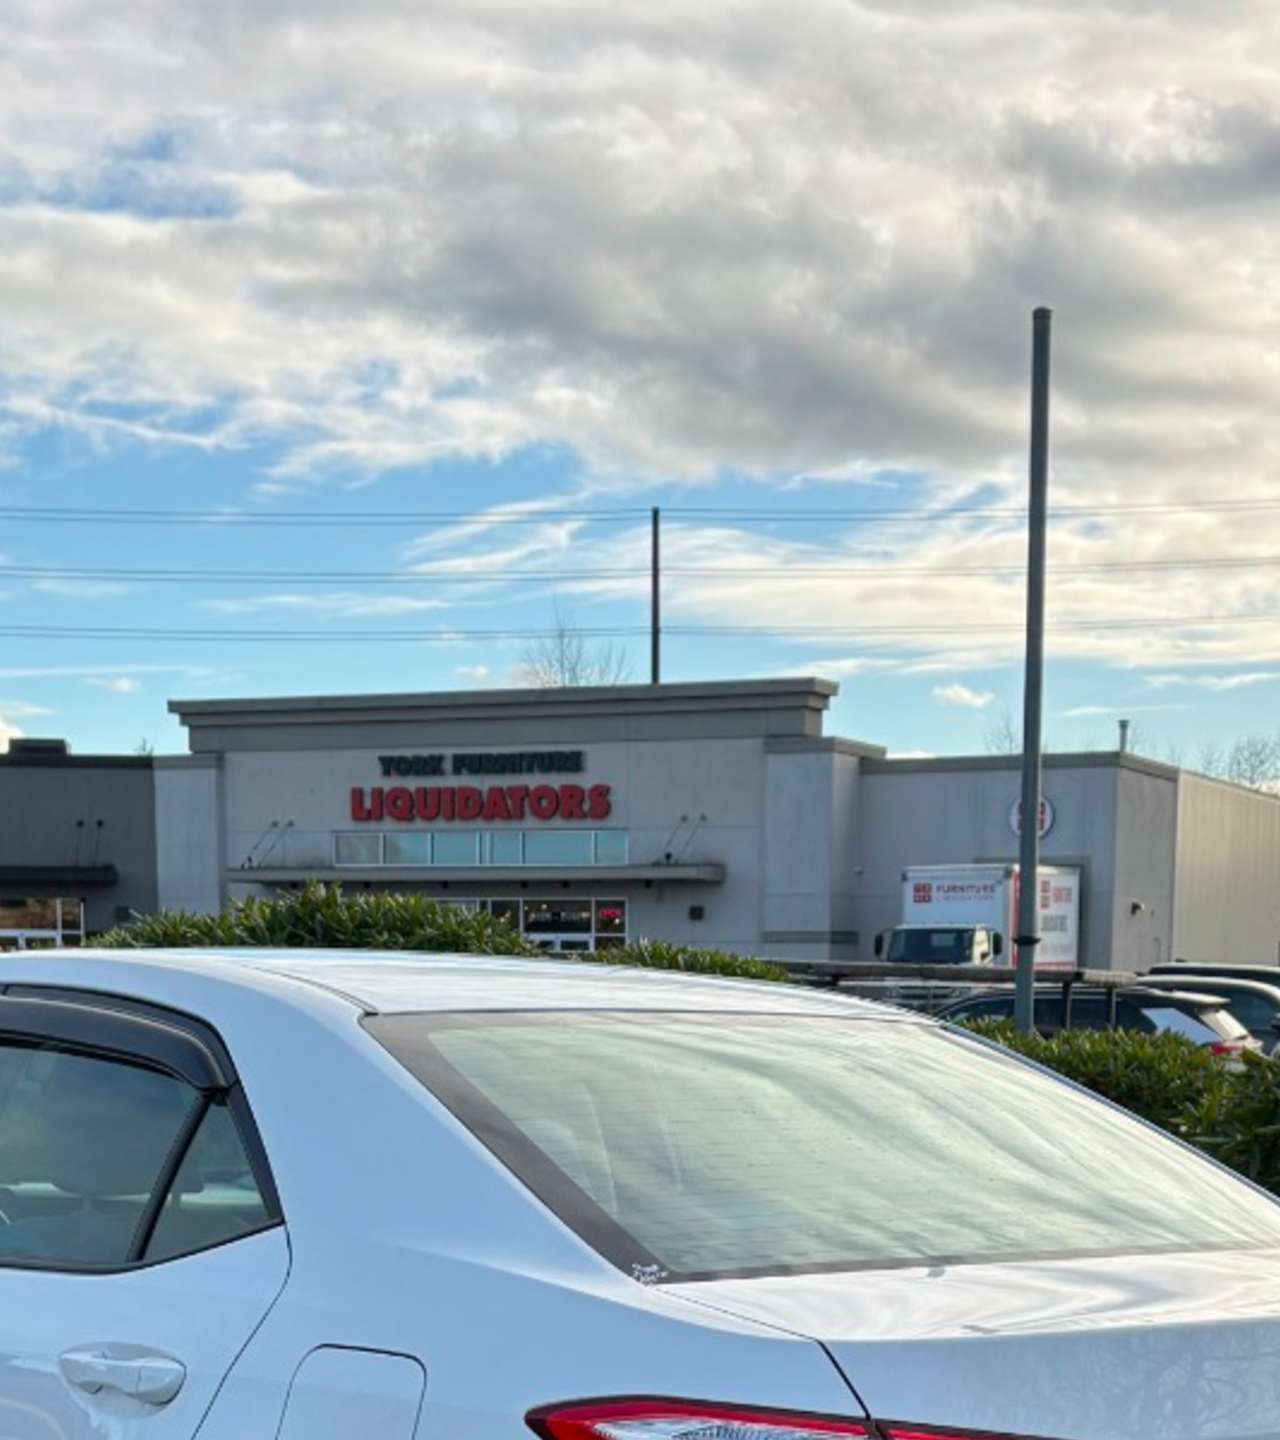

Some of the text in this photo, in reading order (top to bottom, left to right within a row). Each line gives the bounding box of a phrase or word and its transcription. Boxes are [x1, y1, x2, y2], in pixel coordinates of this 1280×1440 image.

[378, 751, 584, 777] YORK FURNITURE
[350, 784, 612, 822] LIQUIDATORS
